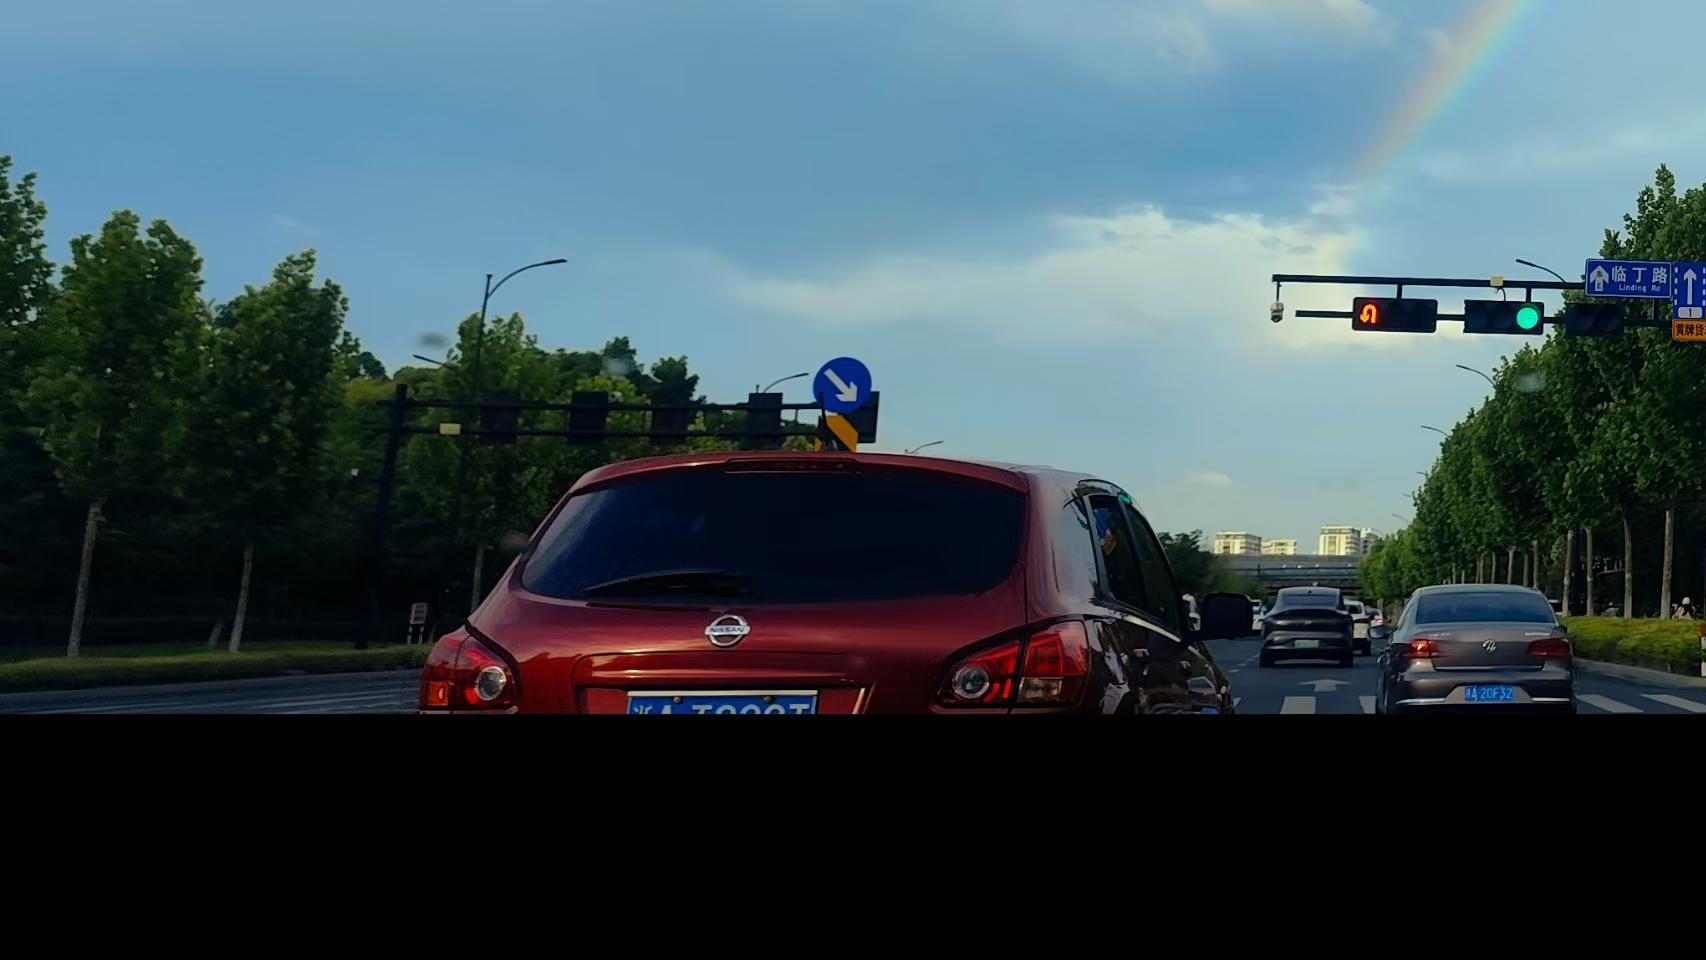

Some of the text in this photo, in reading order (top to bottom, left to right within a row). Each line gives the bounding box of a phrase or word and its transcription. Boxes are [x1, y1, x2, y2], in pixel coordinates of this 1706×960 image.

[1612, 265, 1667, 284] 临丁路
[1618, 283, 1647, 292] Linding
